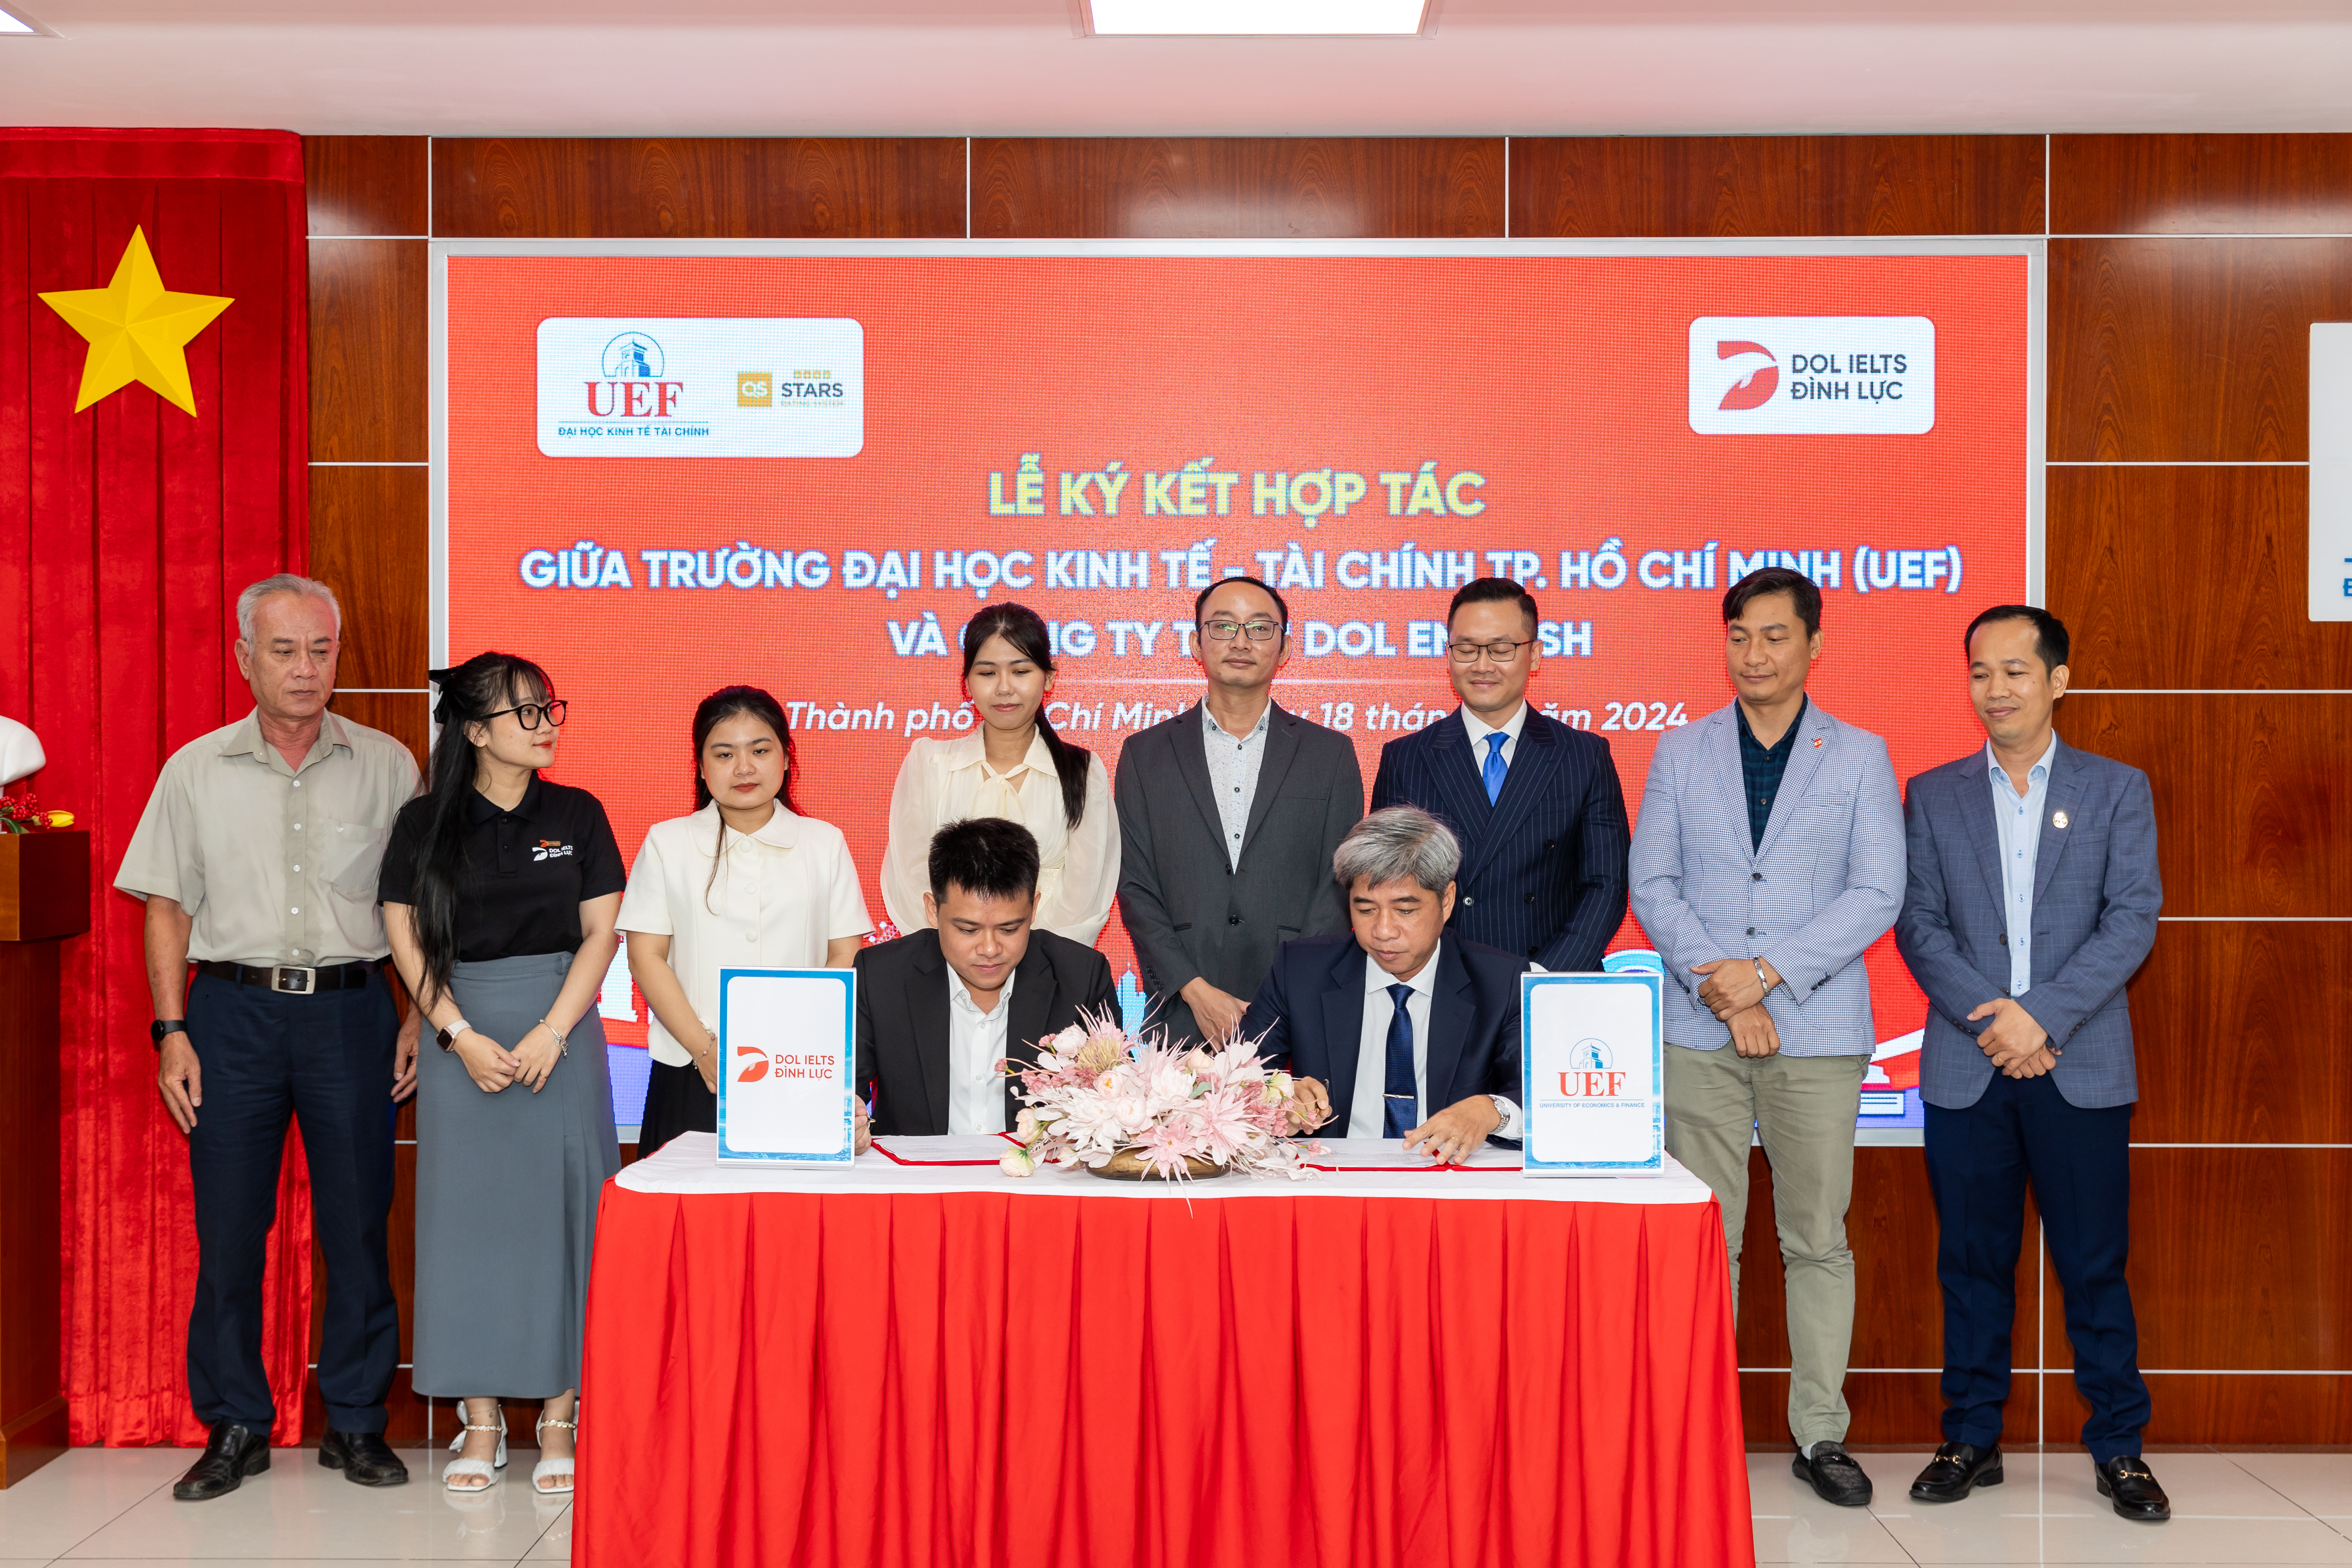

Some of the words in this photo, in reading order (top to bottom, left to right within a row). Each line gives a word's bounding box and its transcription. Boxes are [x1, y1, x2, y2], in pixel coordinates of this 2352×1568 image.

[1792, 354, 1841, 373] DOL
[1849, 354, 1907, 373] IELTS
[584, 382, 683, 417] UEF
[782, 383, 843, 397] STARS
[1791, 377, 1849, 400] ĐÌNH
[1858, 380, 1903, 404] LỰC
[558, 427, 576, 438] ĐẠI
[580, 427, 603, 438] HỌC
[607, 427, 634, 436] KINH
[637, 424, 651, 436] TẾ
[654, 425, 671, 436] TÀI
[675, 425, 709, 436] CHÍNH
[988, 453, 1046, 516] LỄ
[1059, 460, 1132, 516] KÝ
[1143, 456, 1240, 516] KẾT
[1252, 466, 1368, 529] HỢP
[1378, 460, 1489, 516] TÁC
[520, 540, 633, 588] GIỮA
[641, 540, 831, 588] TRƯỜNG
[842, 550, 921, 599] ĐẠI
[934, 550, 1034, 599] HỌC
[1046, 550, 1149, 588] KINH
[1159, 537, 1216, 588] TẾ
[1256, 541, 1326, 588] TÀI
[1336, 541, 1476, 588] CHÍNH
[1486, 550, 1547, 589] TP.
[1560, 537, 1628, 589] HỒ
[1638, 540, 1719, 589] CHÍ
[1853, 545, 1963, 593] (UEF)
[887, 610, 949, 656] VÀ
[1107, 621, 1165, 656] TY
[1304, 620, 1397, 657] DOL
[786, 701, 895, 730] Thành
[904, 700, 974, 737] phố
[1044, 701, 1104, 730] Chí
[1320, 701, 1355, 730] 18
[1365, 701, 1447, 730] thán
[1601, 701, 1688, 730] 2024
[775, 1054, 800, 1065] DOL
[805, 1055, 835, 1065] IELTS
[775, 1066, 805, 1078] ĐÌNH
[809, 1068, 833, 1080] LỰC
[1557, 1072, 1626, 1096] UEF
